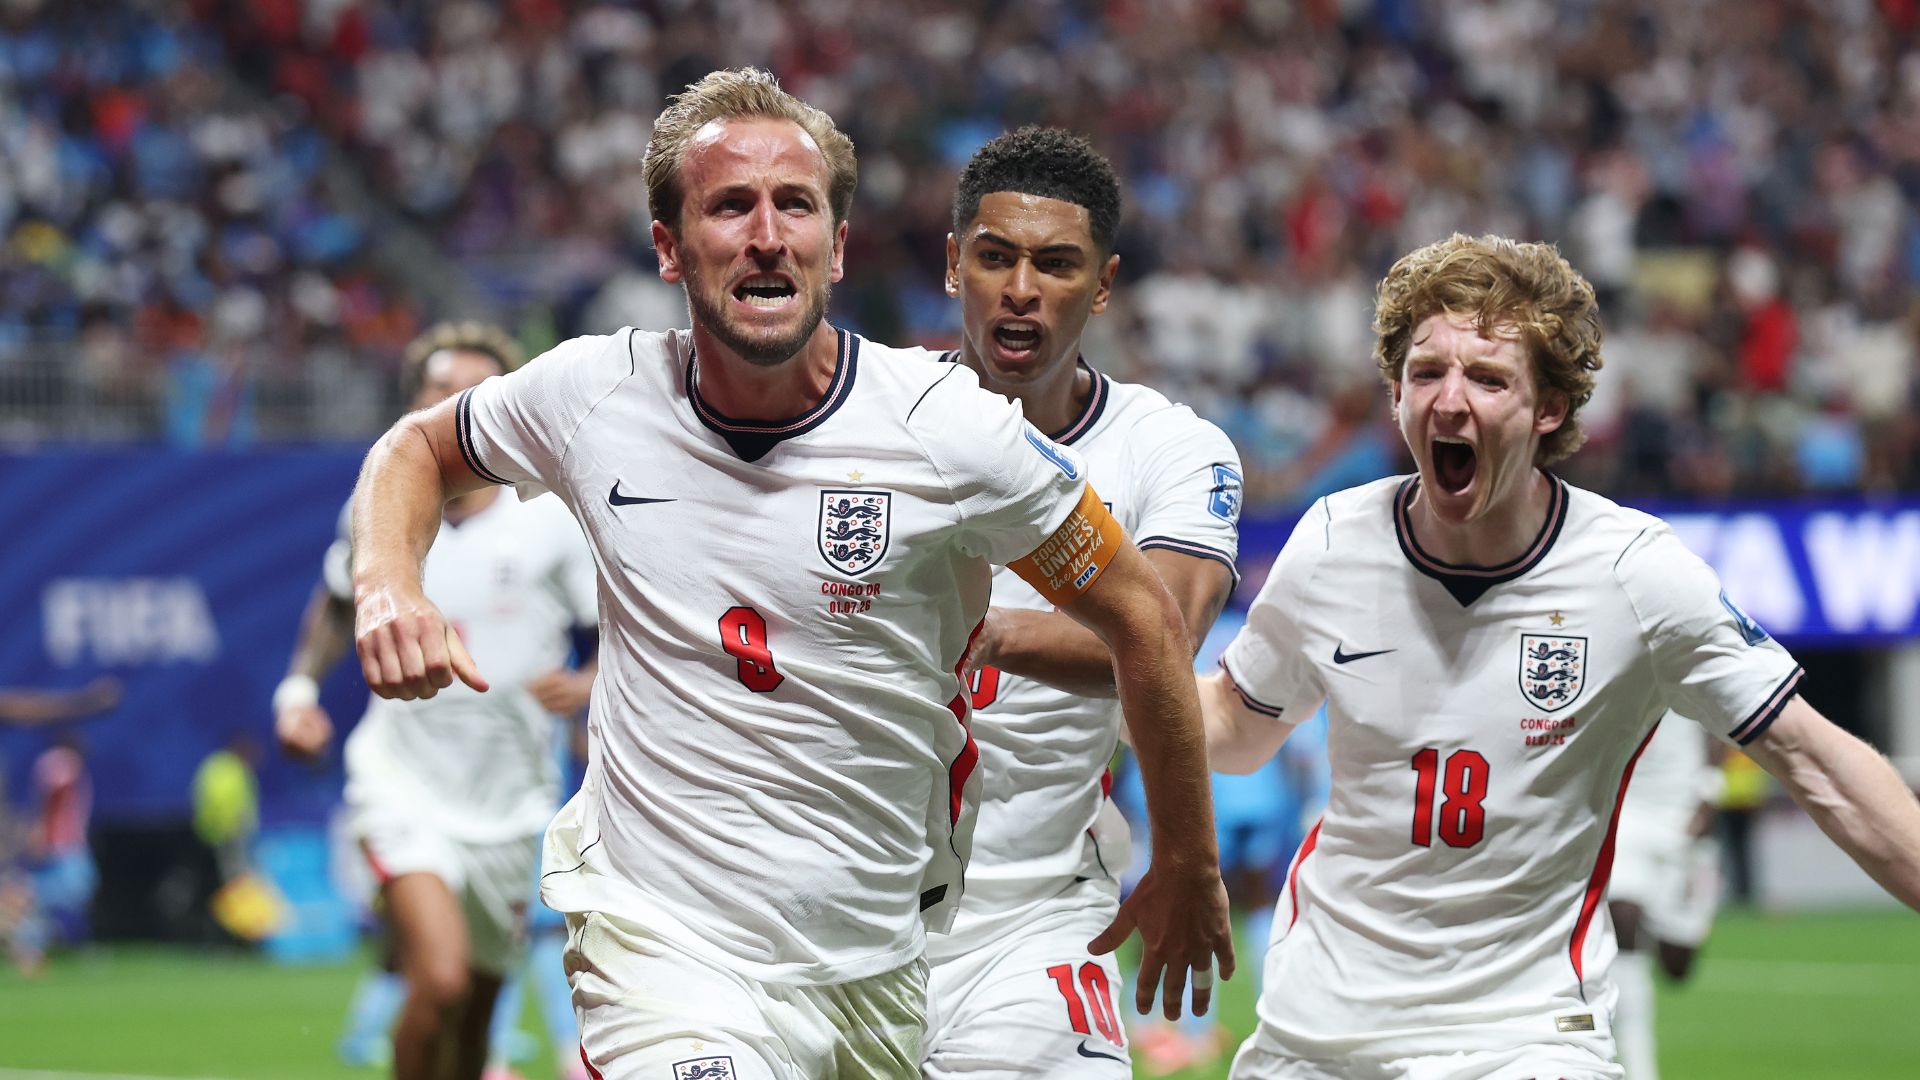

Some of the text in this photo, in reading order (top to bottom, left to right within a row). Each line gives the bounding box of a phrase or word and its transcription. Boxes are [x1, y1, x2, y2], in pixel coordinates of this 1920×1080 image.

[1031, 510, 1085, 566] FOOTBALL
[1039, 519, 1094, 578] UNITES
[1048, 529, 1104, 591] the World
[821, 582, 881, 597] CONGO DR
[1076, 566, 1097, 587] FIFA
[830, 600, 871, 614] 01.07.26
[718, 606, 785, 693] 9
[1520, 716, 1576, 731] CONGO DR
[1412, 747, 1490, 848] 18
[1047, 961, 1124, 1047] 10
